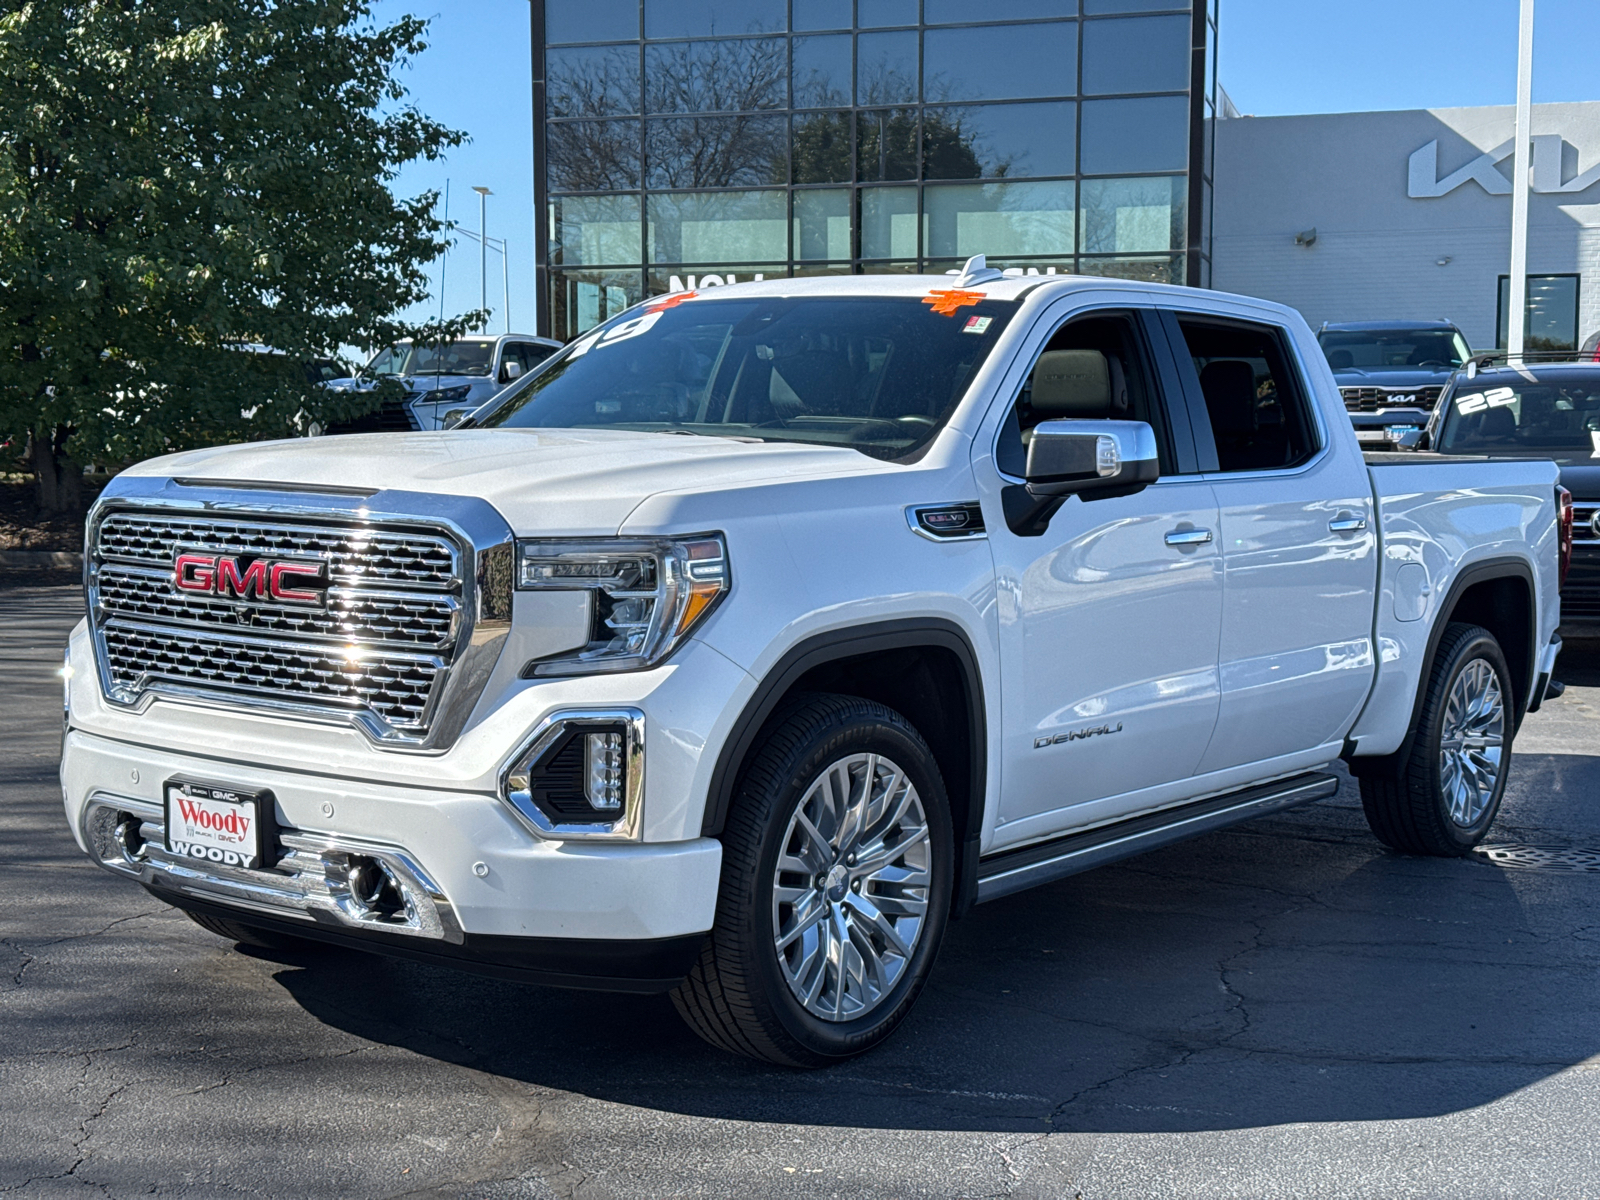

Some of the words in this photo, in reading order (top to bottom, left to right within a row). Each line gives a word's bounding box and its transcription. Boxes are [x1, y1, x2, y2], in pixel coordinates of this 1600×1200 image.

[565, 311, 664, 361] 19
[1387, 394, 1416, 402] KIA
[1456, 387, 1517, 416] 22
[175, 554, 322, 605] GMC
[1034, 721, 1123, 749] DENALI
[212, 790, 237, 802] GMC
[176, 798, 251, 842] Woody
[218, 834, 237, 844] GMC
[170, 840, 254, 868] WOODY
